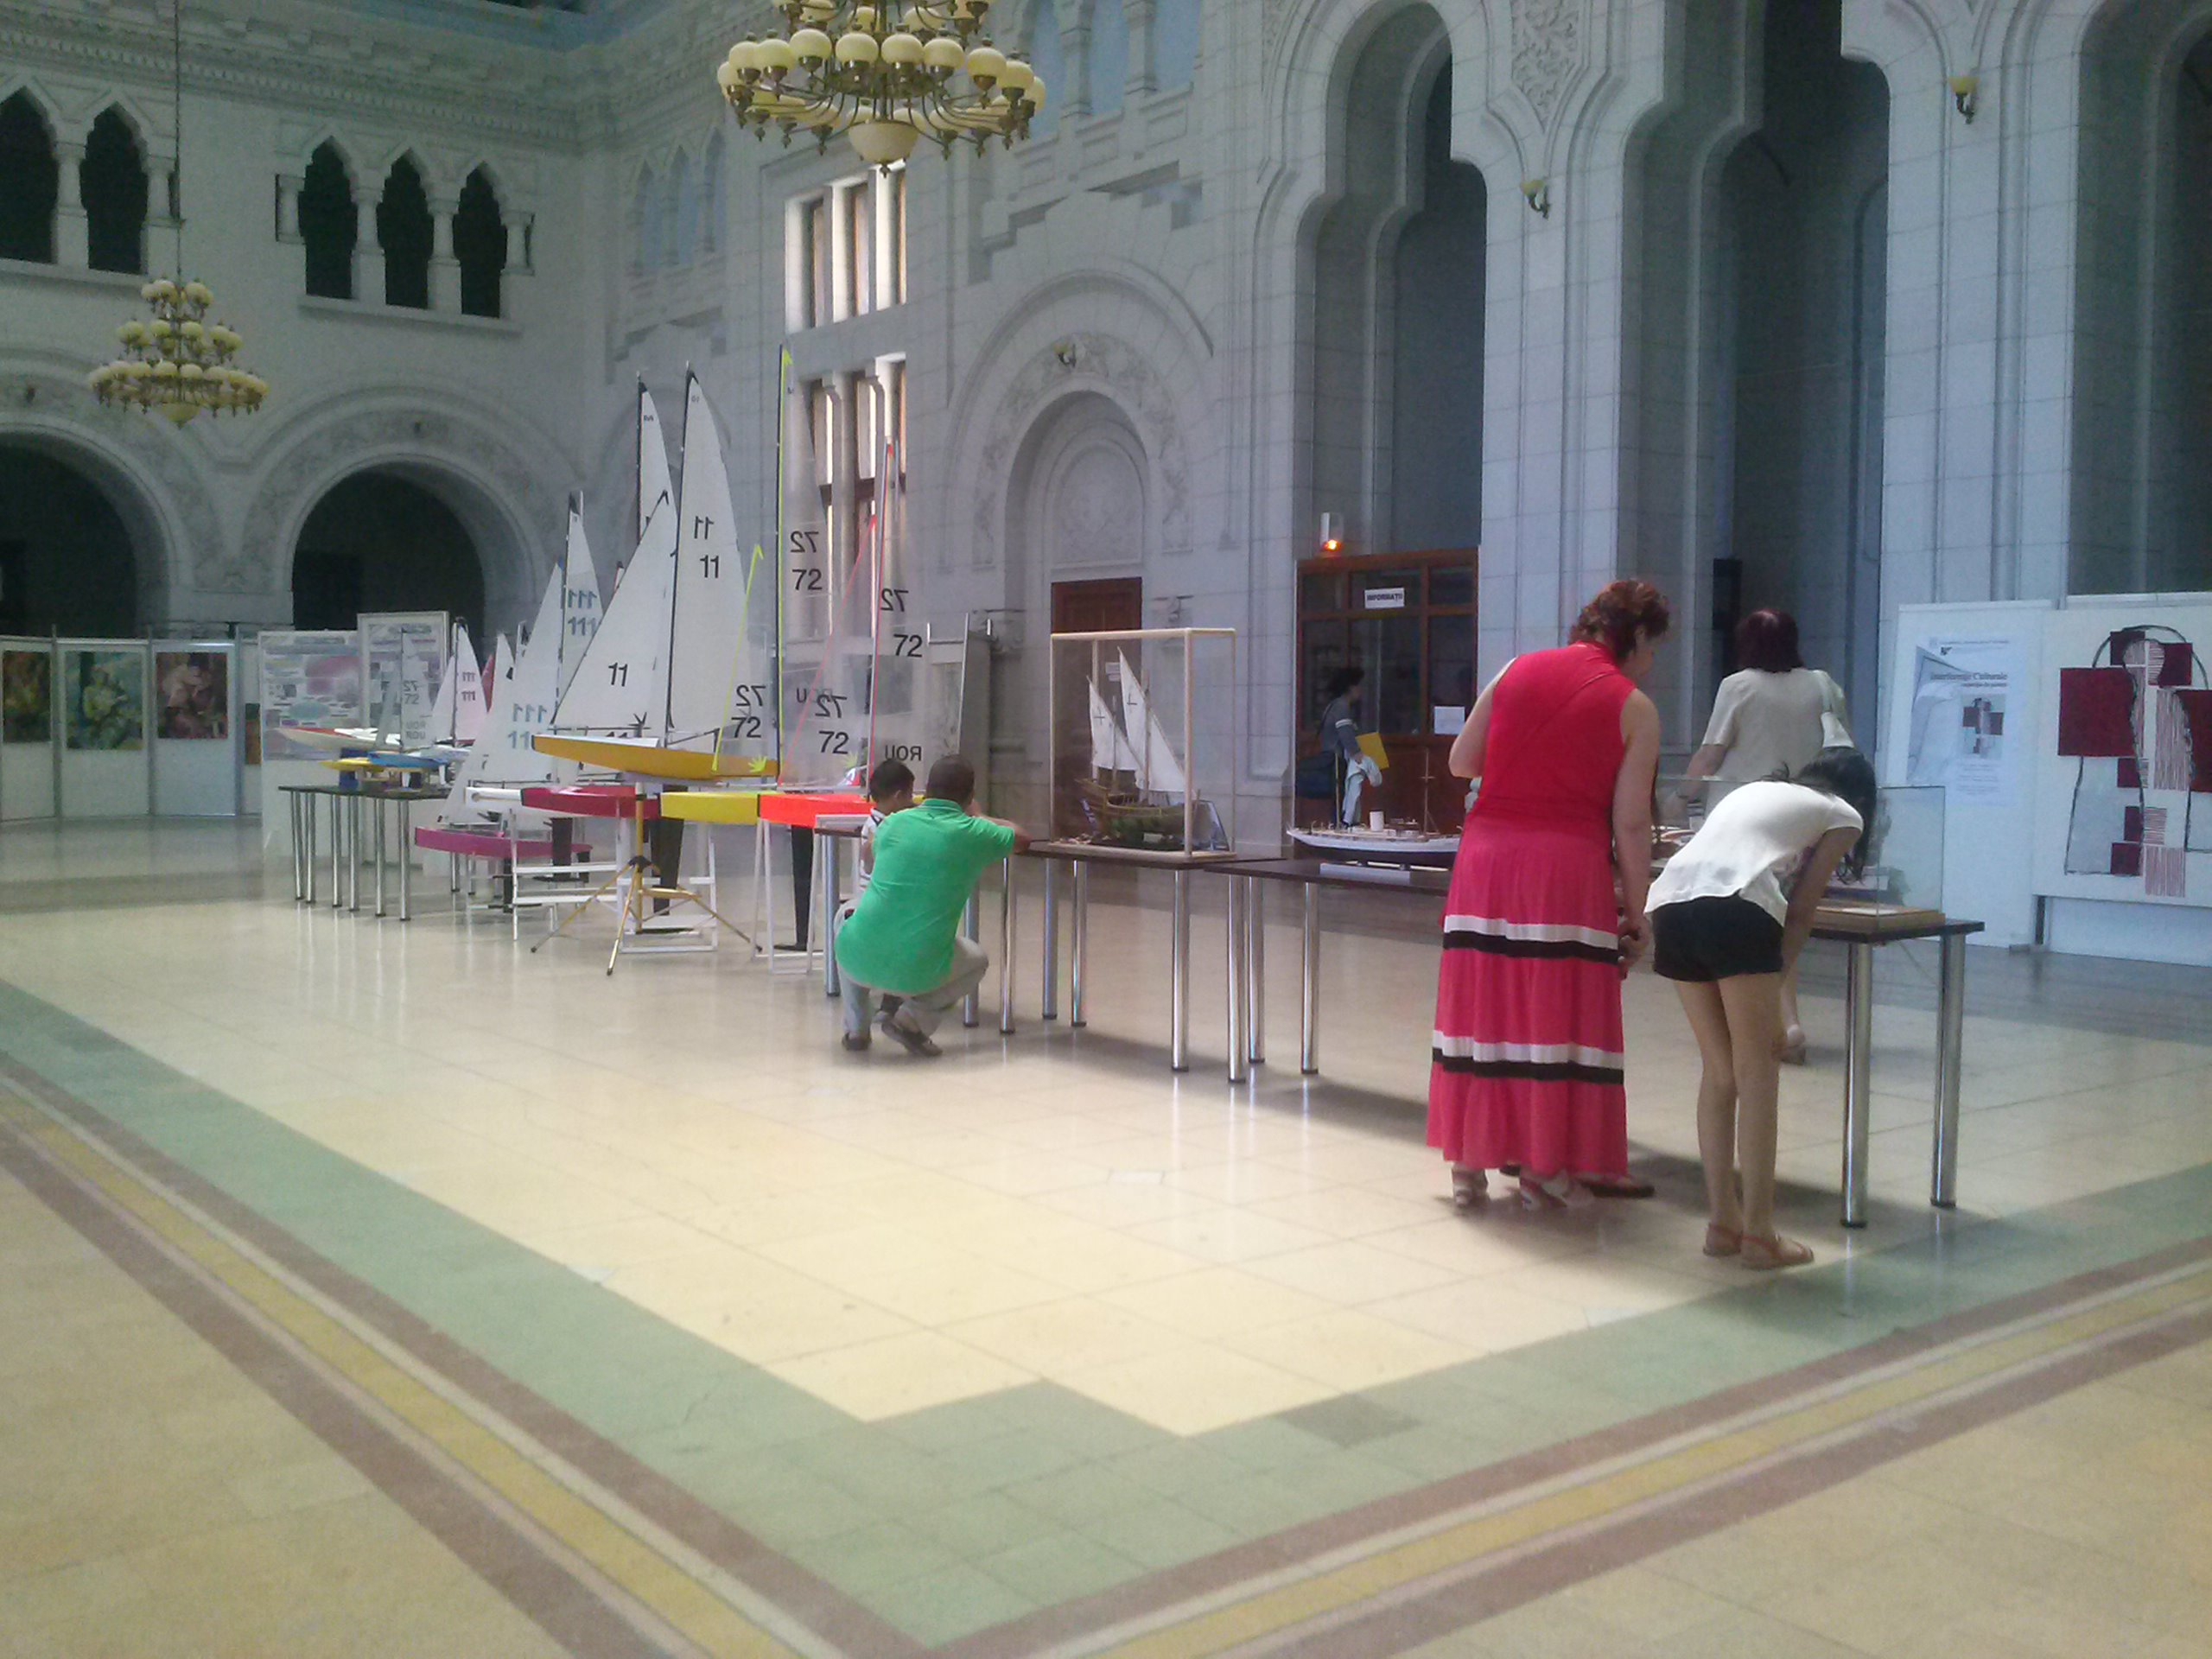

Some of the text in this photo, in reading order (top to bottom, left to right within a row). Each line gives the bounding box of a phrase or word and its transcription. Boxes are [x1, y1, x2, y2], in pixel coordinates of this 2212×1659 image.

[700, 555, 719, 578] 11
[792, 569, 823, 590] 72
[893, 633, 922, 657] 72
[608, 662, 628, 686] 11
[731, 716, 761, 738] 72
[819, 731, 849, 754] 72
